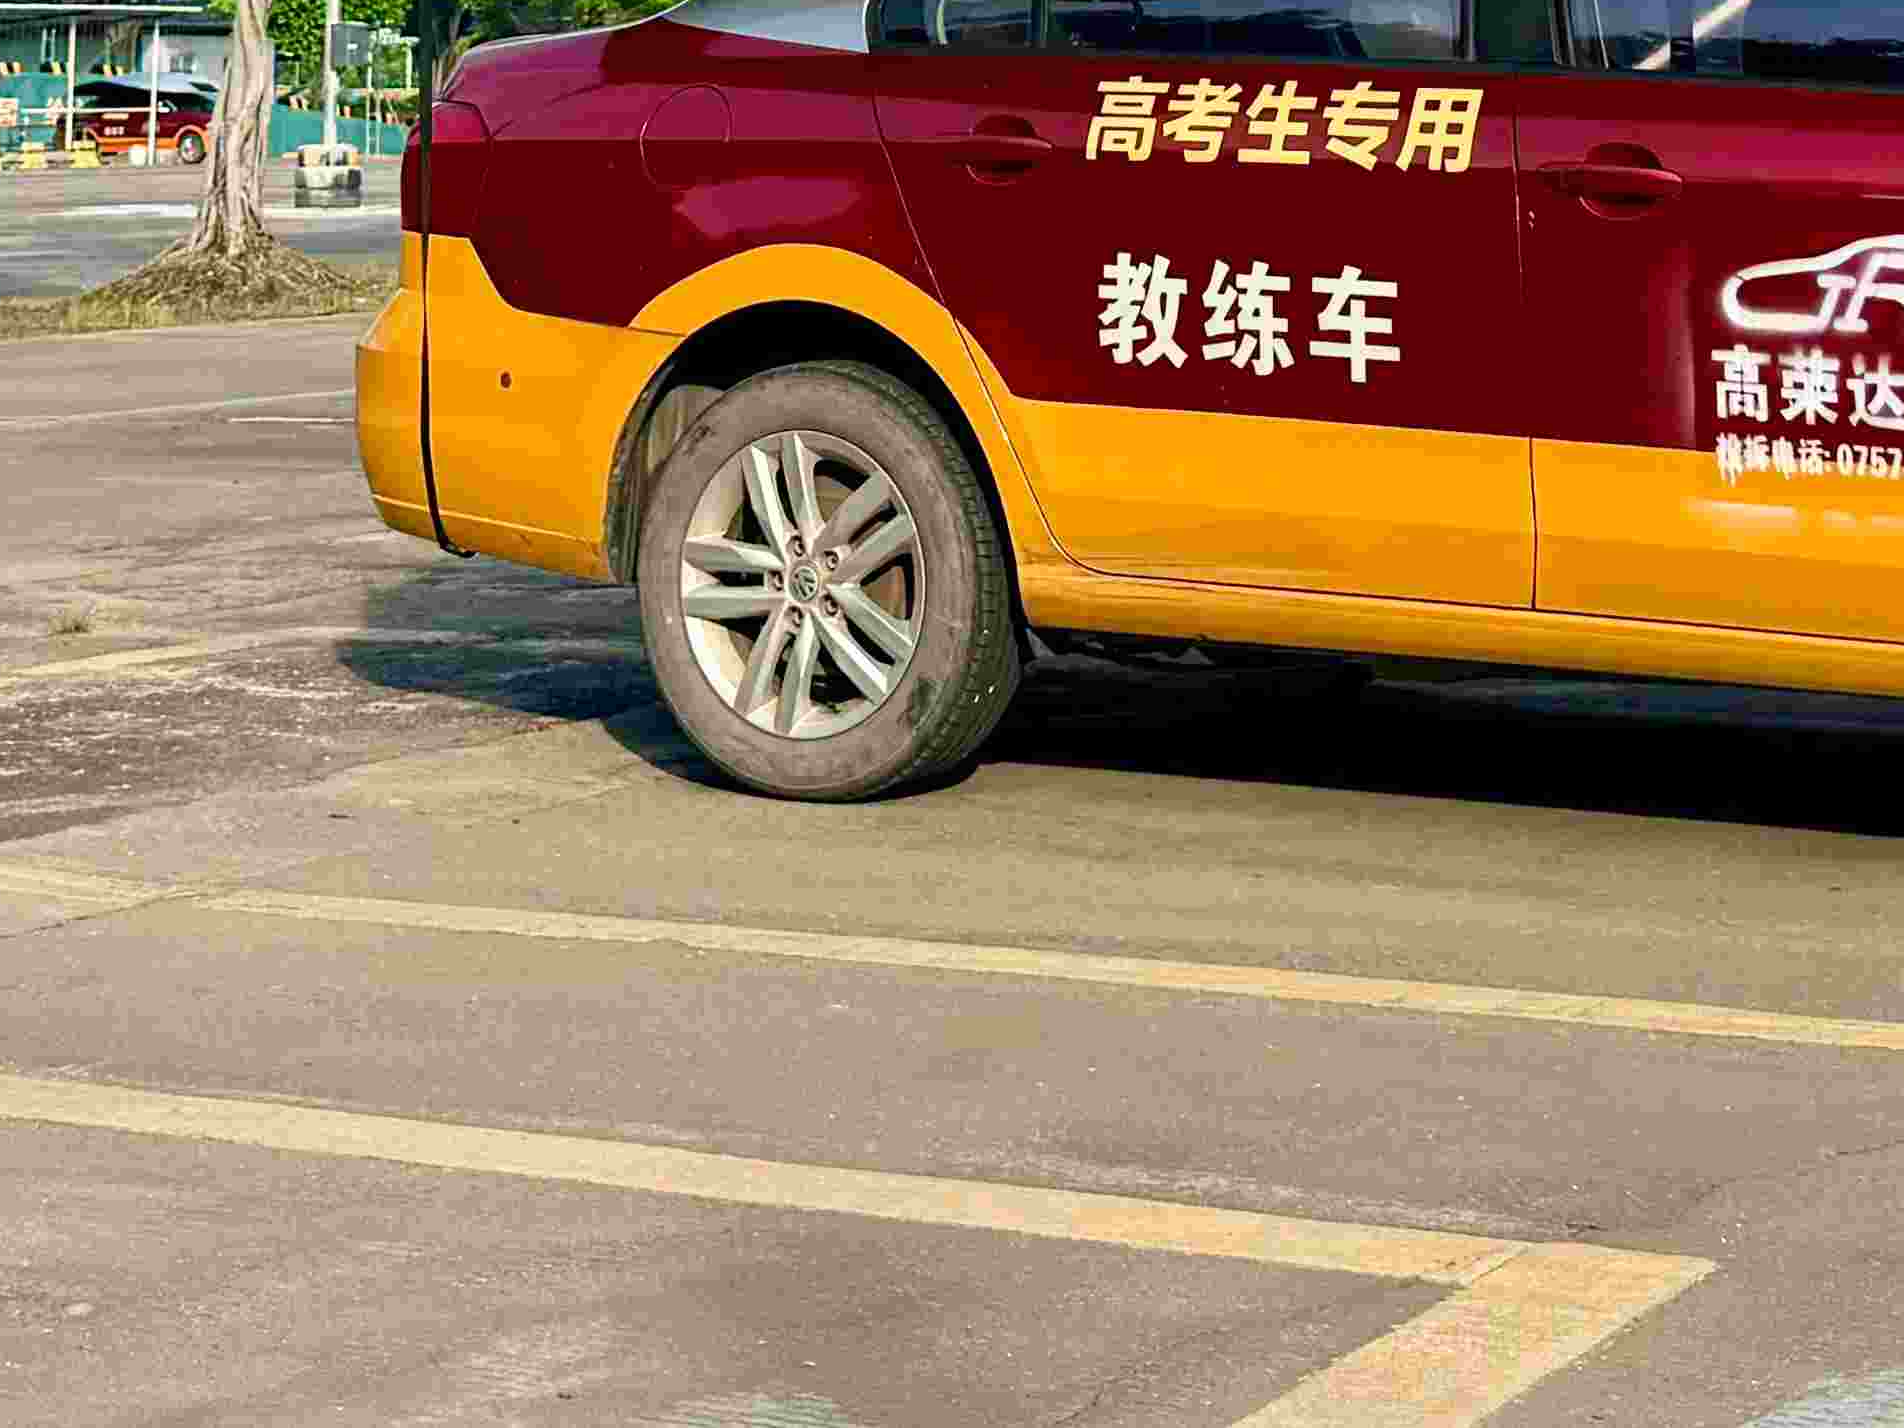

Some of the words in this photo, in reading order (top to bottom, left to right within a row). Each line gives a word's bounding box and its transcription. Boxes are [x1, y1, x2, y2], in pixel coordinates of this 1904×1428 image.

[1085, 76, 1483, 173] 高考生专用
[1098, 252, 1401, 383] 教练车
